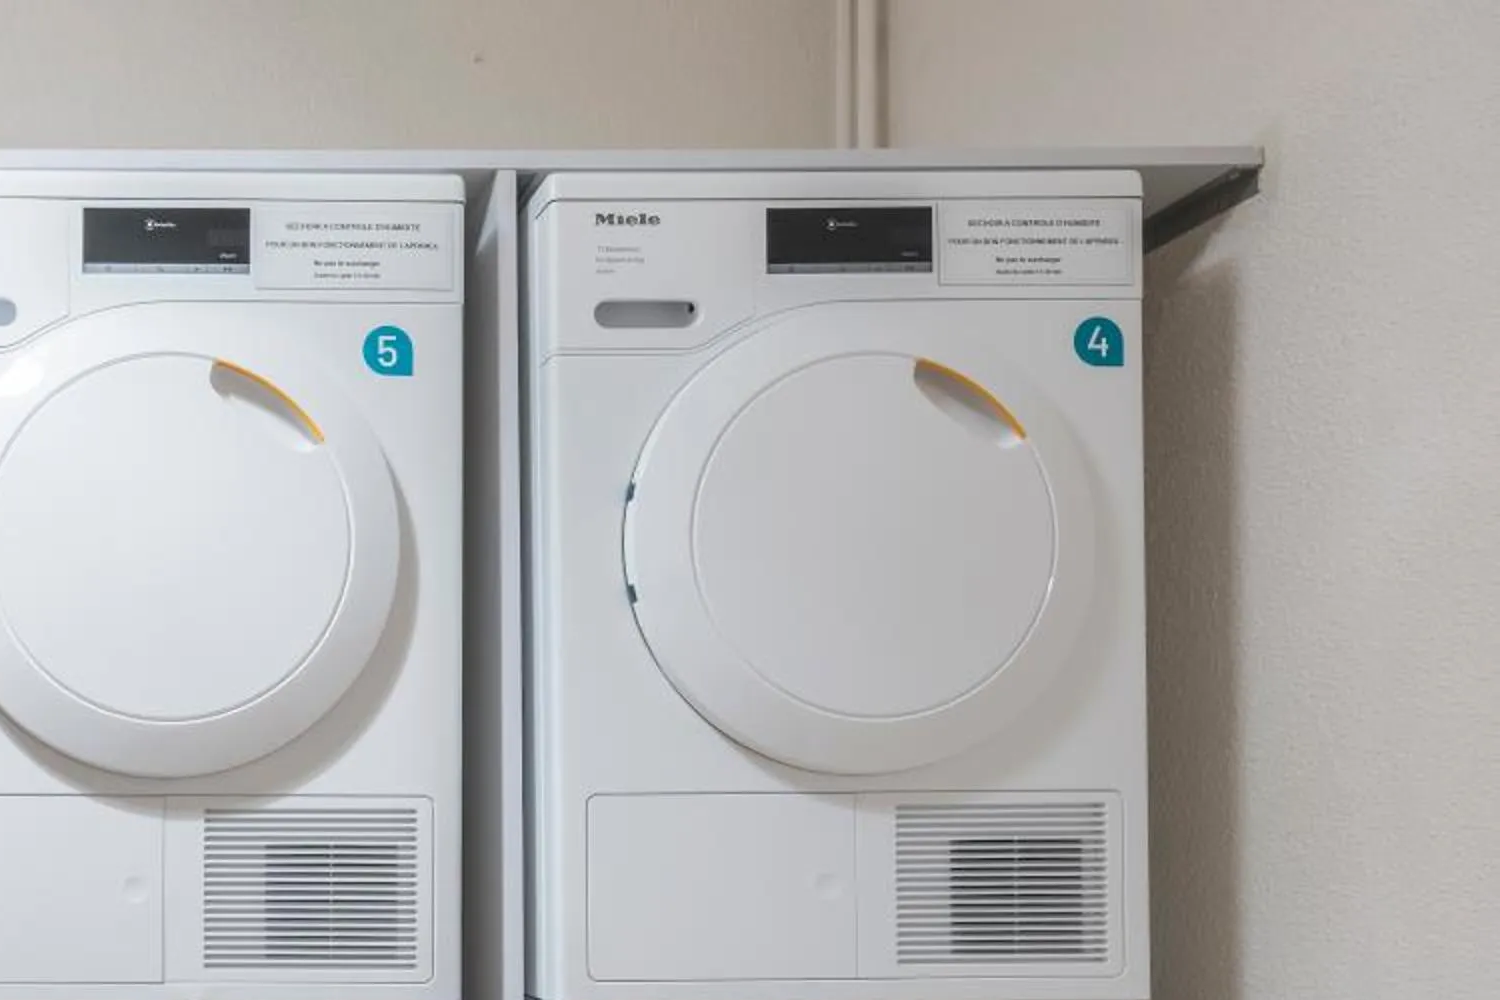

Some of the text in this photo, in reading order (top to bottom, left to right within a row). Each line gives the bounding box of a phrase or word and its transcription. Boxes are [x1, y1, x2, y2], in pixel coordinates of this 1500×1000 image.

[595, 213, 661, 226] Miele
[377, 335, 397, 367] 5
[1087, 325, 1109, 358] 4
